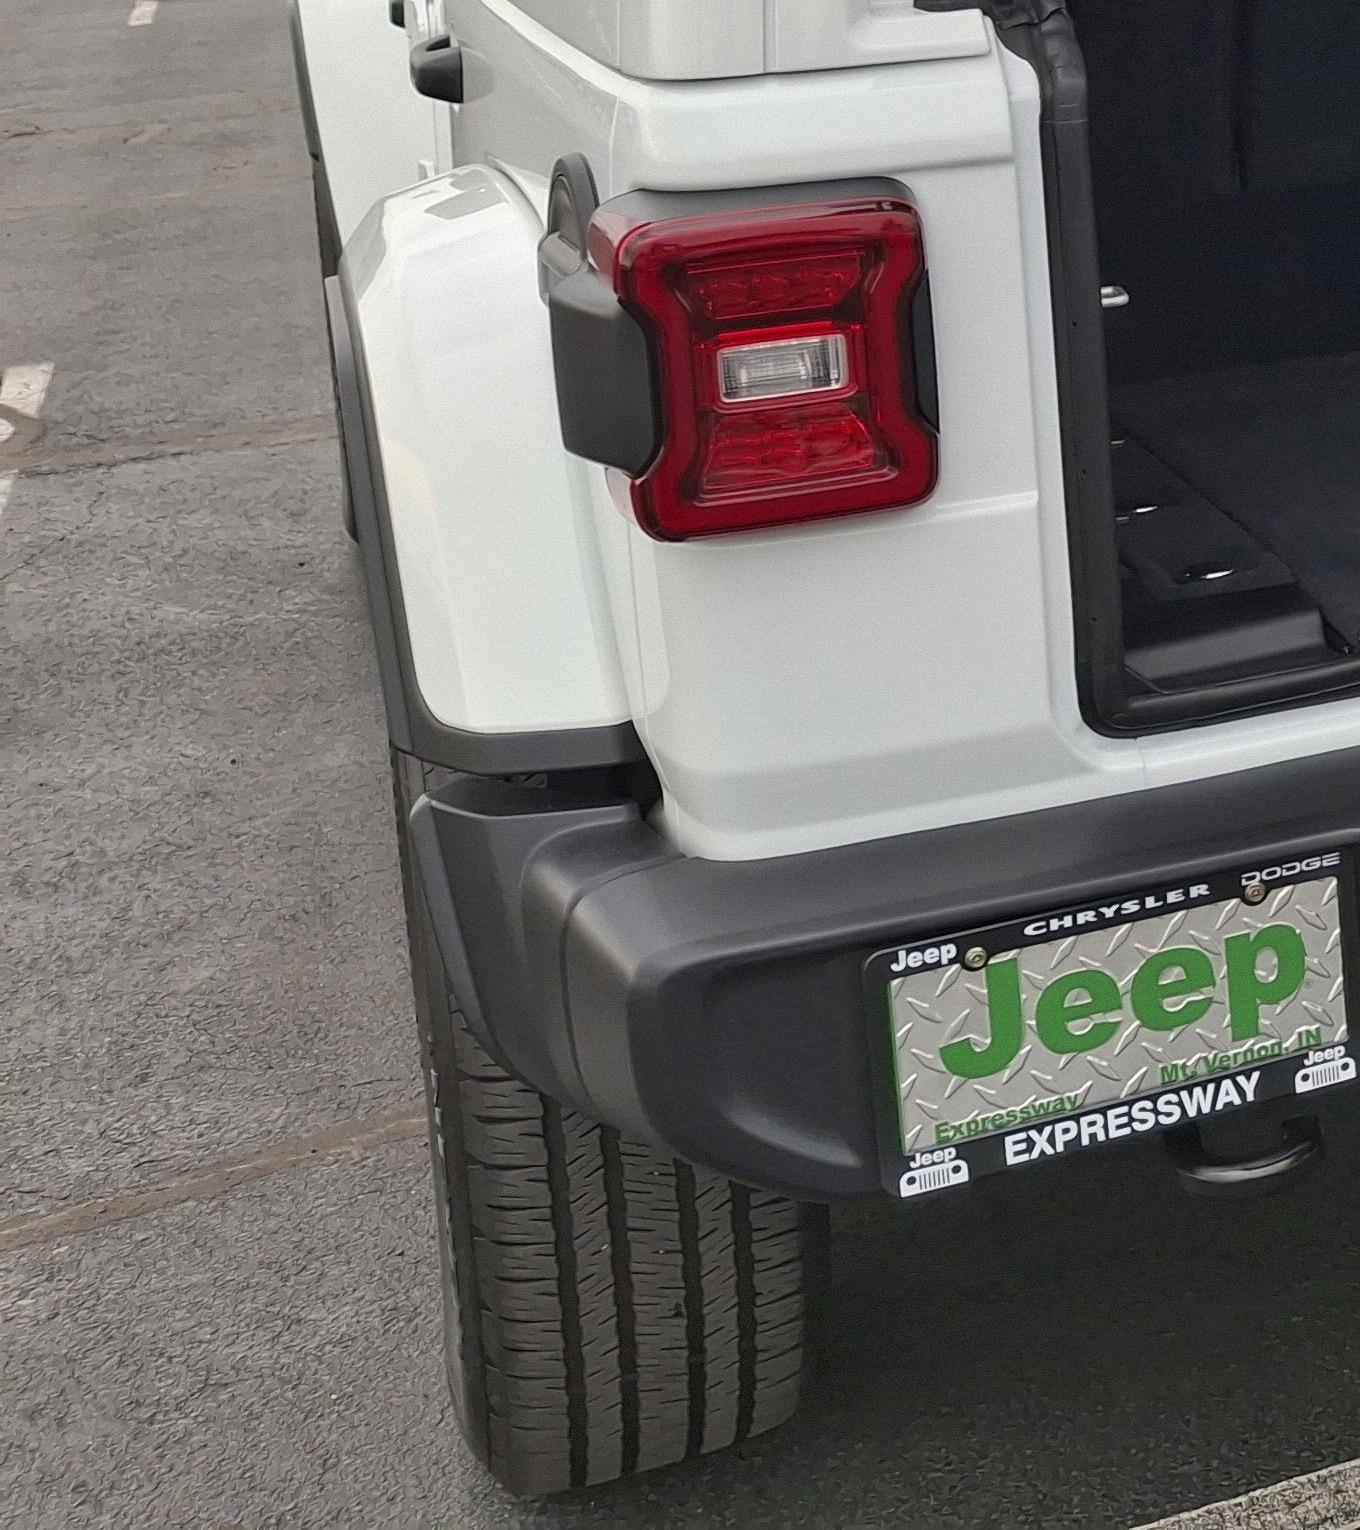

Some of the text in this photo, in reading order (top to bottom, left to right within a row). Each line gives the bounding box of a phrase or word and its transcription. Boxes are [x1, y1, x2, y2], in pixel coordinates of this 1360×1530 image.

[1240, 851, 1341, 887] DODGE
[1022, 883, 1211, 937] CHRYSLER
[890, 942, 958, 974] Jeep
[938, 923, 1308, 1081] Jeep
[1160, 1062, 1198, 1086] Mt.
[1297, 1026, 1322, 1048] IN
[1303, 1045, 1346, 1067] Jeep
[934, 1092, 1079, 1145] Expressway
[1004, 1070, 1262, 1167] EXPRESSWAY
[909, 1146, 957, 1169] Jeep
